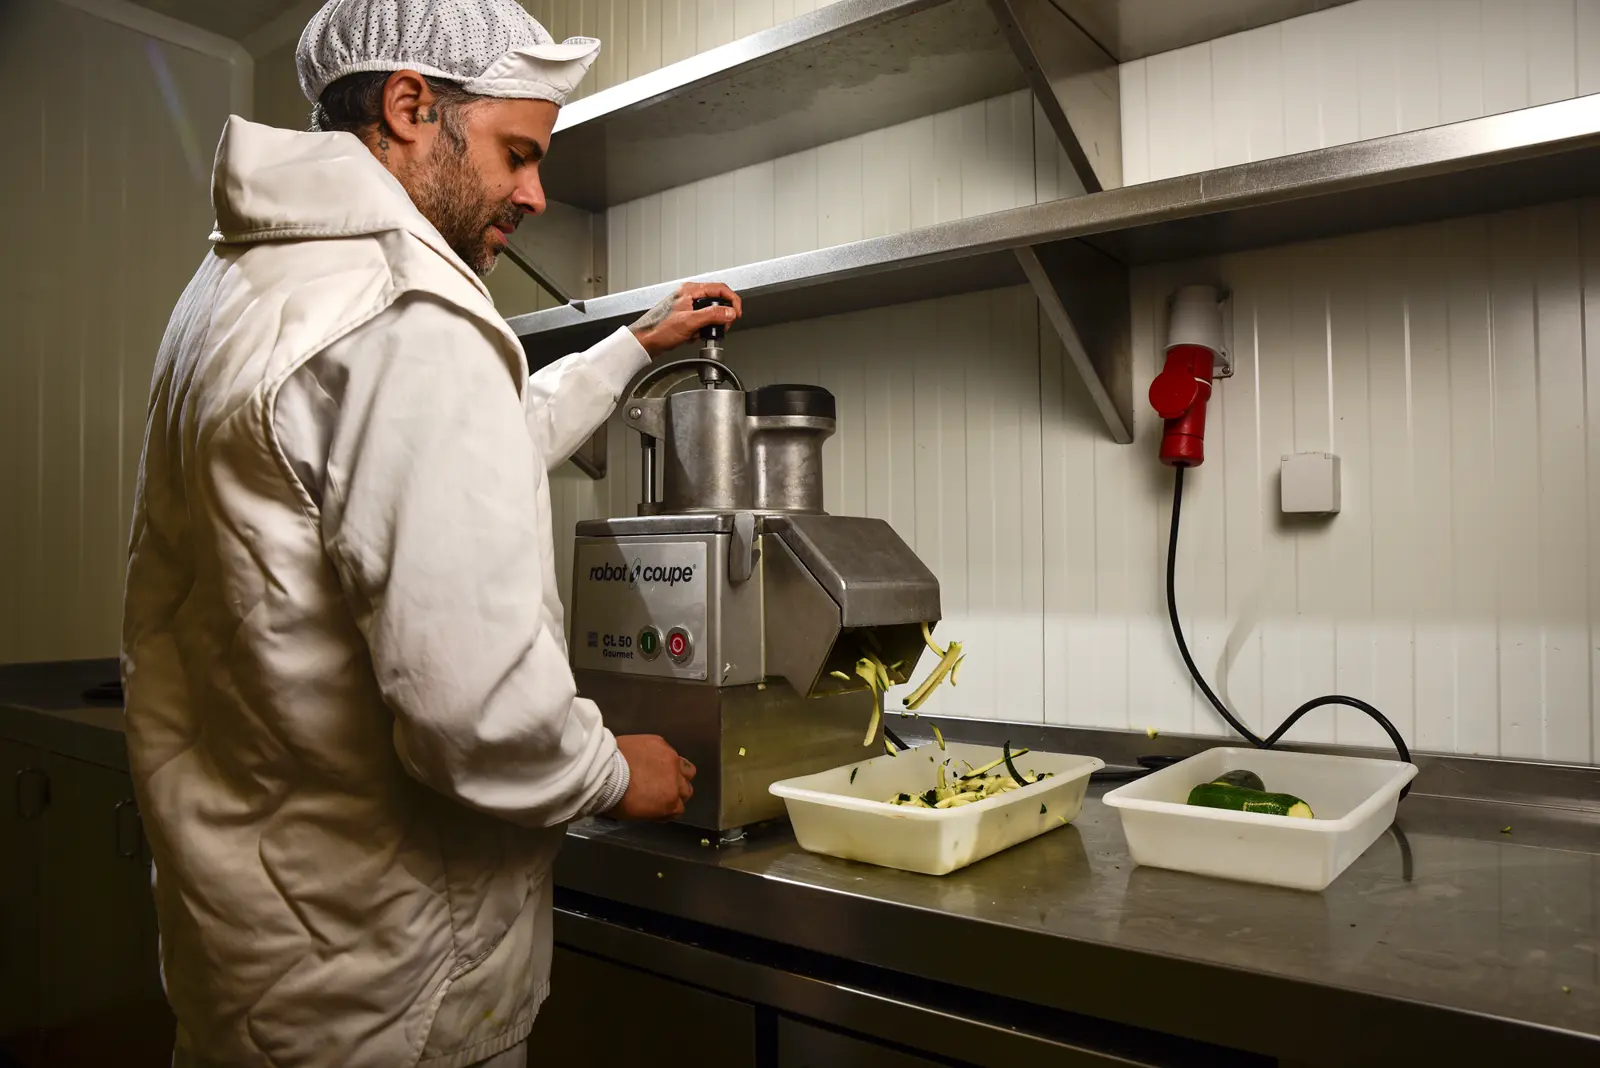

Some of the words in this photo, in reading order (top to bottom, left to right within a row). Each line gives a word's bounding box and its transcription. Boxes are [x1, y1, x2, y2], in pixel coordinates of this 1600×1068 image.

[589, 562, 627, 582] robot
[603, 634, 617, 647] CL
[619, 636, 632, 648] 50
[603, 649, 634, 659] Gourmet
